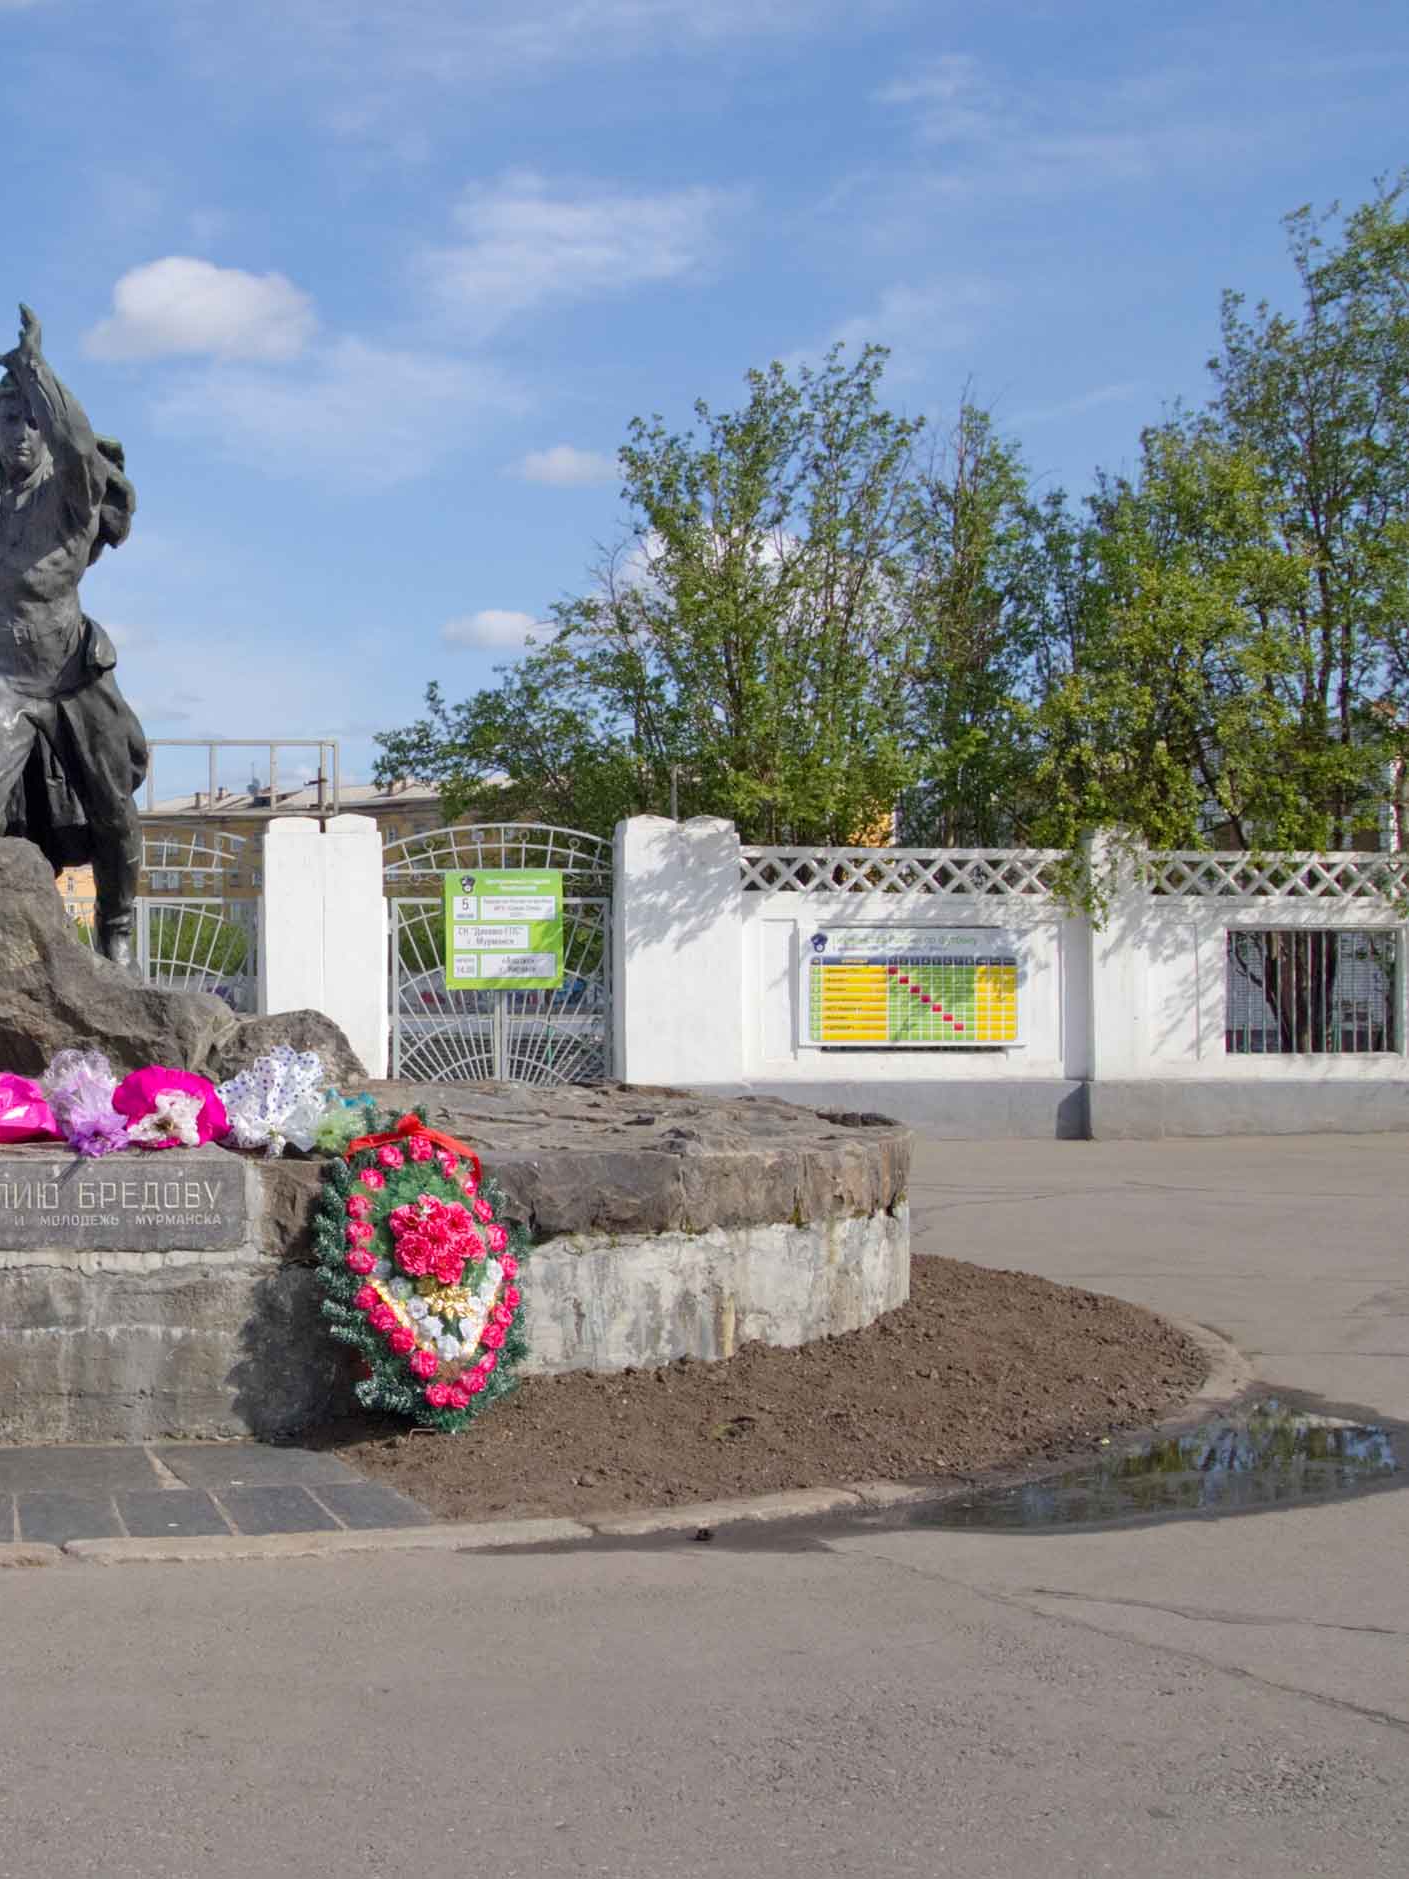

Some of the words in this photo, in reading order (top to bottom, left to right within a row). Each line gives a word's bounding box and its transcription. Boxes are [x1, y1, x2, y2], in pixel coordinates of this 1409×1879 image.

[462, 898, 470, 910] 5
[79, 1181, 222, 1212] БРЕДОВУ
[15, 1215, 25, 1226] И
[134, 1213, 222, 1225] МУРМАНСКА
